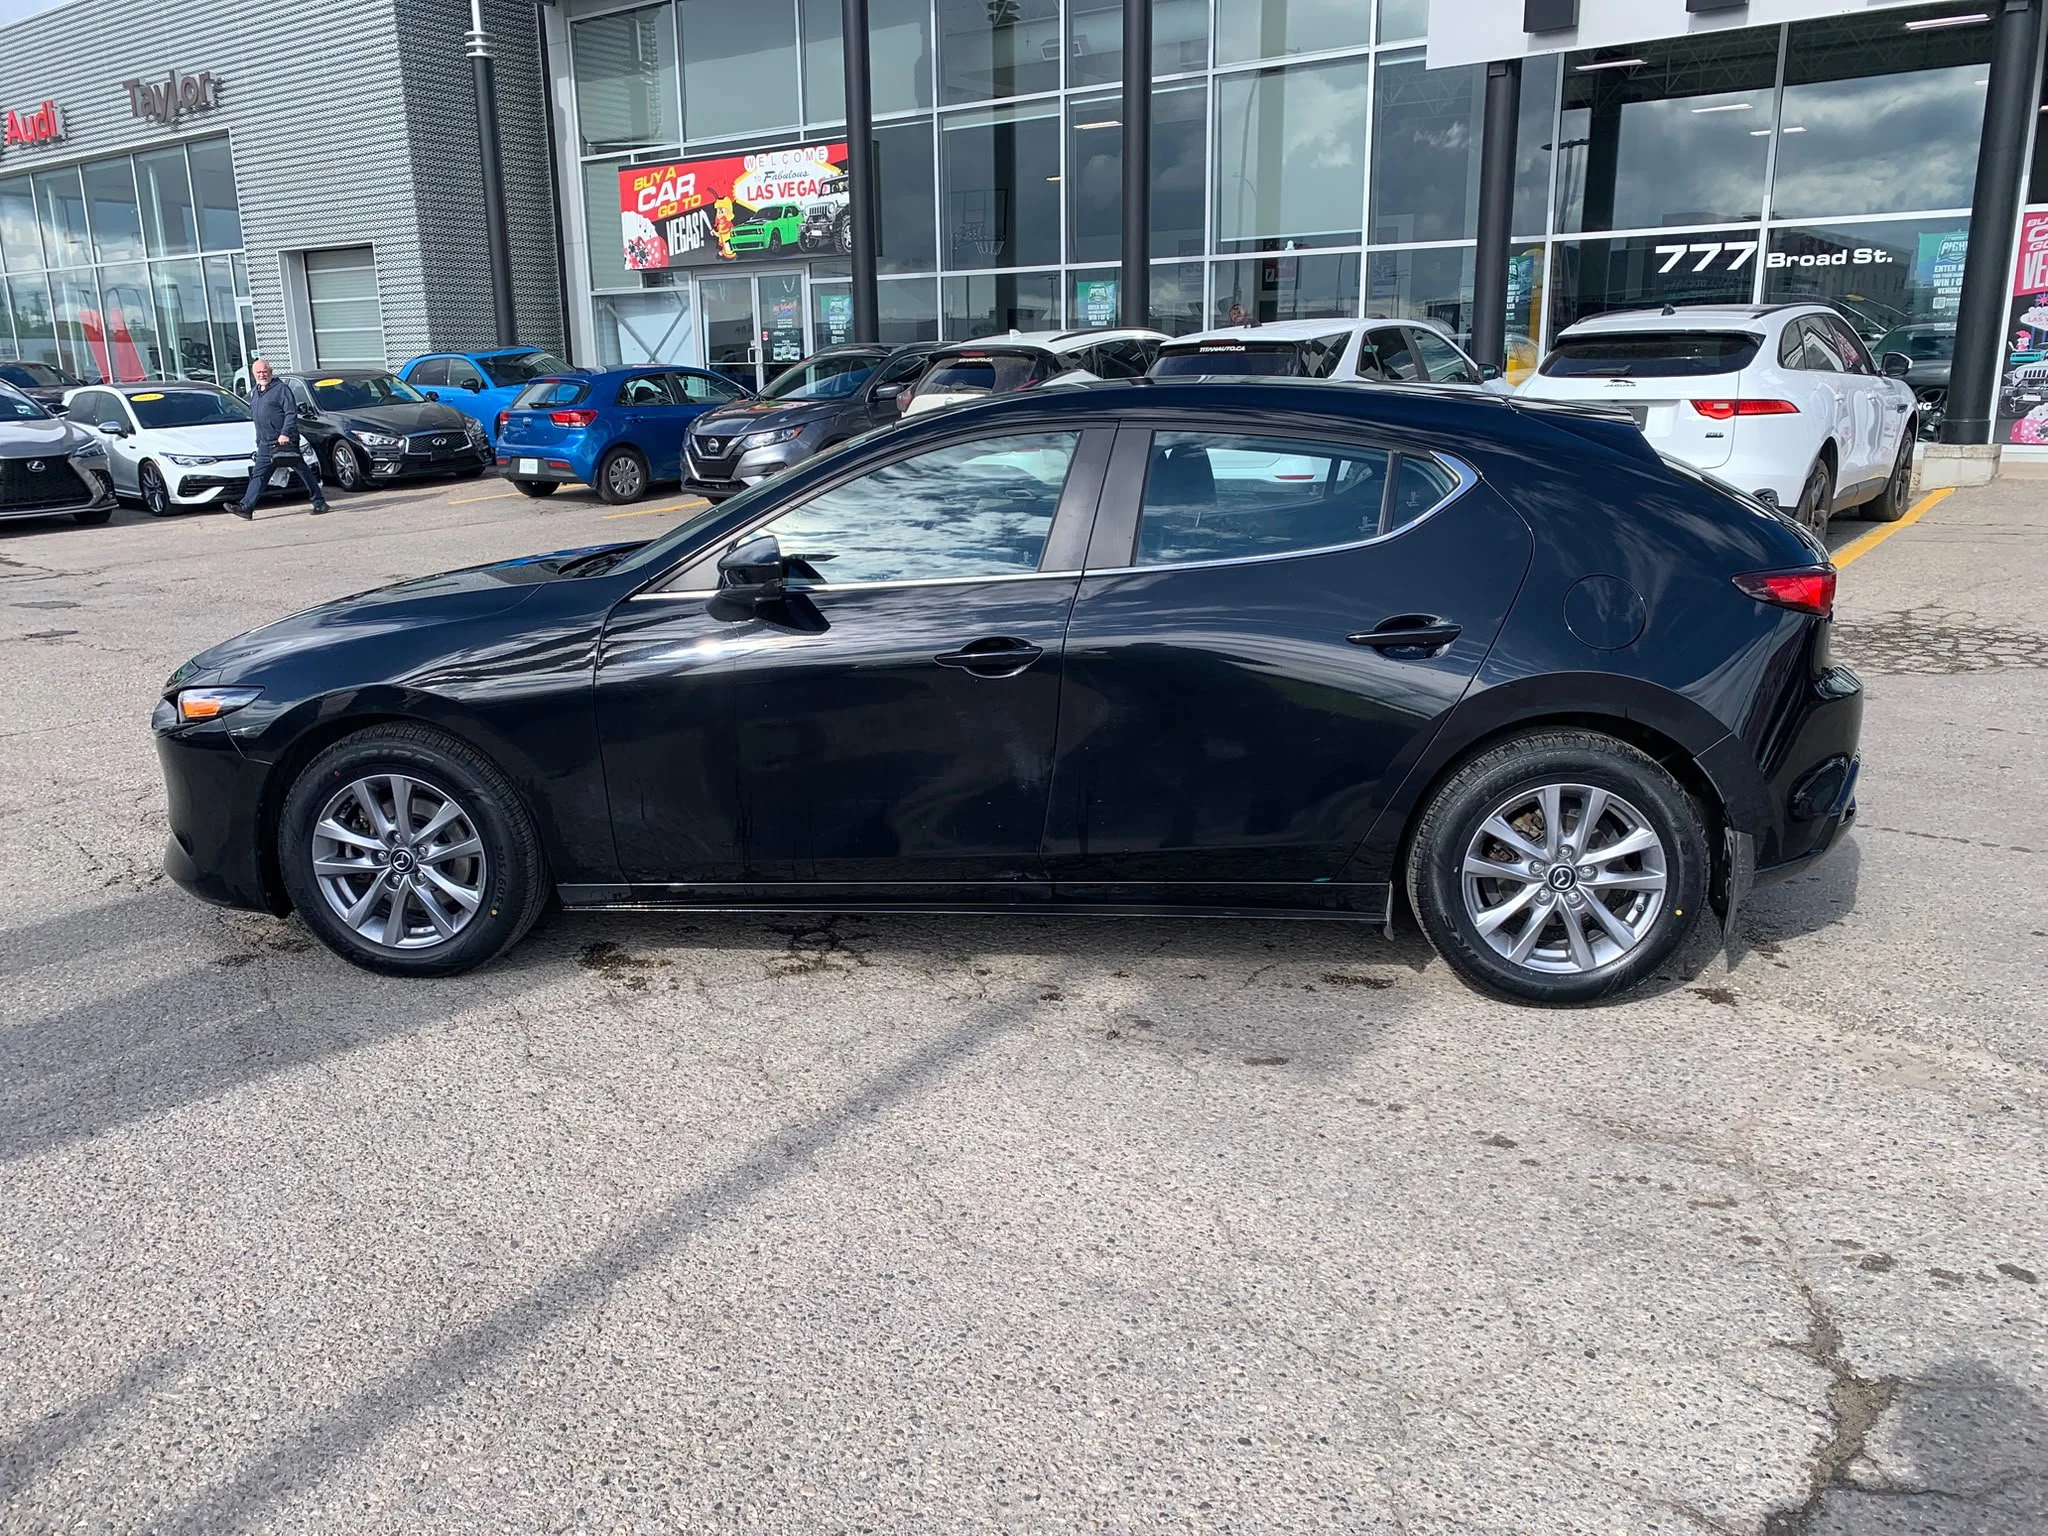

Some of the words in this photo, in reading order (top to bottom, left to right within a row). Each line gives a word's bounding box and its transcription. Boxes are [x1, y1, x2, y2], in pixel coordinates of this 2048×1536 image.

[122, 69, 212, 122] Taylor
[6, 100, 59, 145] Audi
[745, 148, 825, 169] WELCOME
[634, 170, 664, 192] BUY
[665, 166, 677, 181] A
[763, 170, 809, 183] Fabulous
[637, 172, 696, 212] CAR
[746, 183, 774, 202] LAS
[657, 201, 678, 219] GO
[682, 194, 702, 210] TO
[666, 209, 705, 257] VEGAS!
[2025, 217, 2048, 228] BU
[2027, 224, 2048, 243] C
[1655, 241, 1758, 273] 777
[1766, 249, 1848, 269] Broad
[1852, 247, 1894, 264] St.
[1934, 264, 1957, 273] ENTER
[1933, 278, 1950, 287] WIN
[2022, 250, 2048, 290] VE
